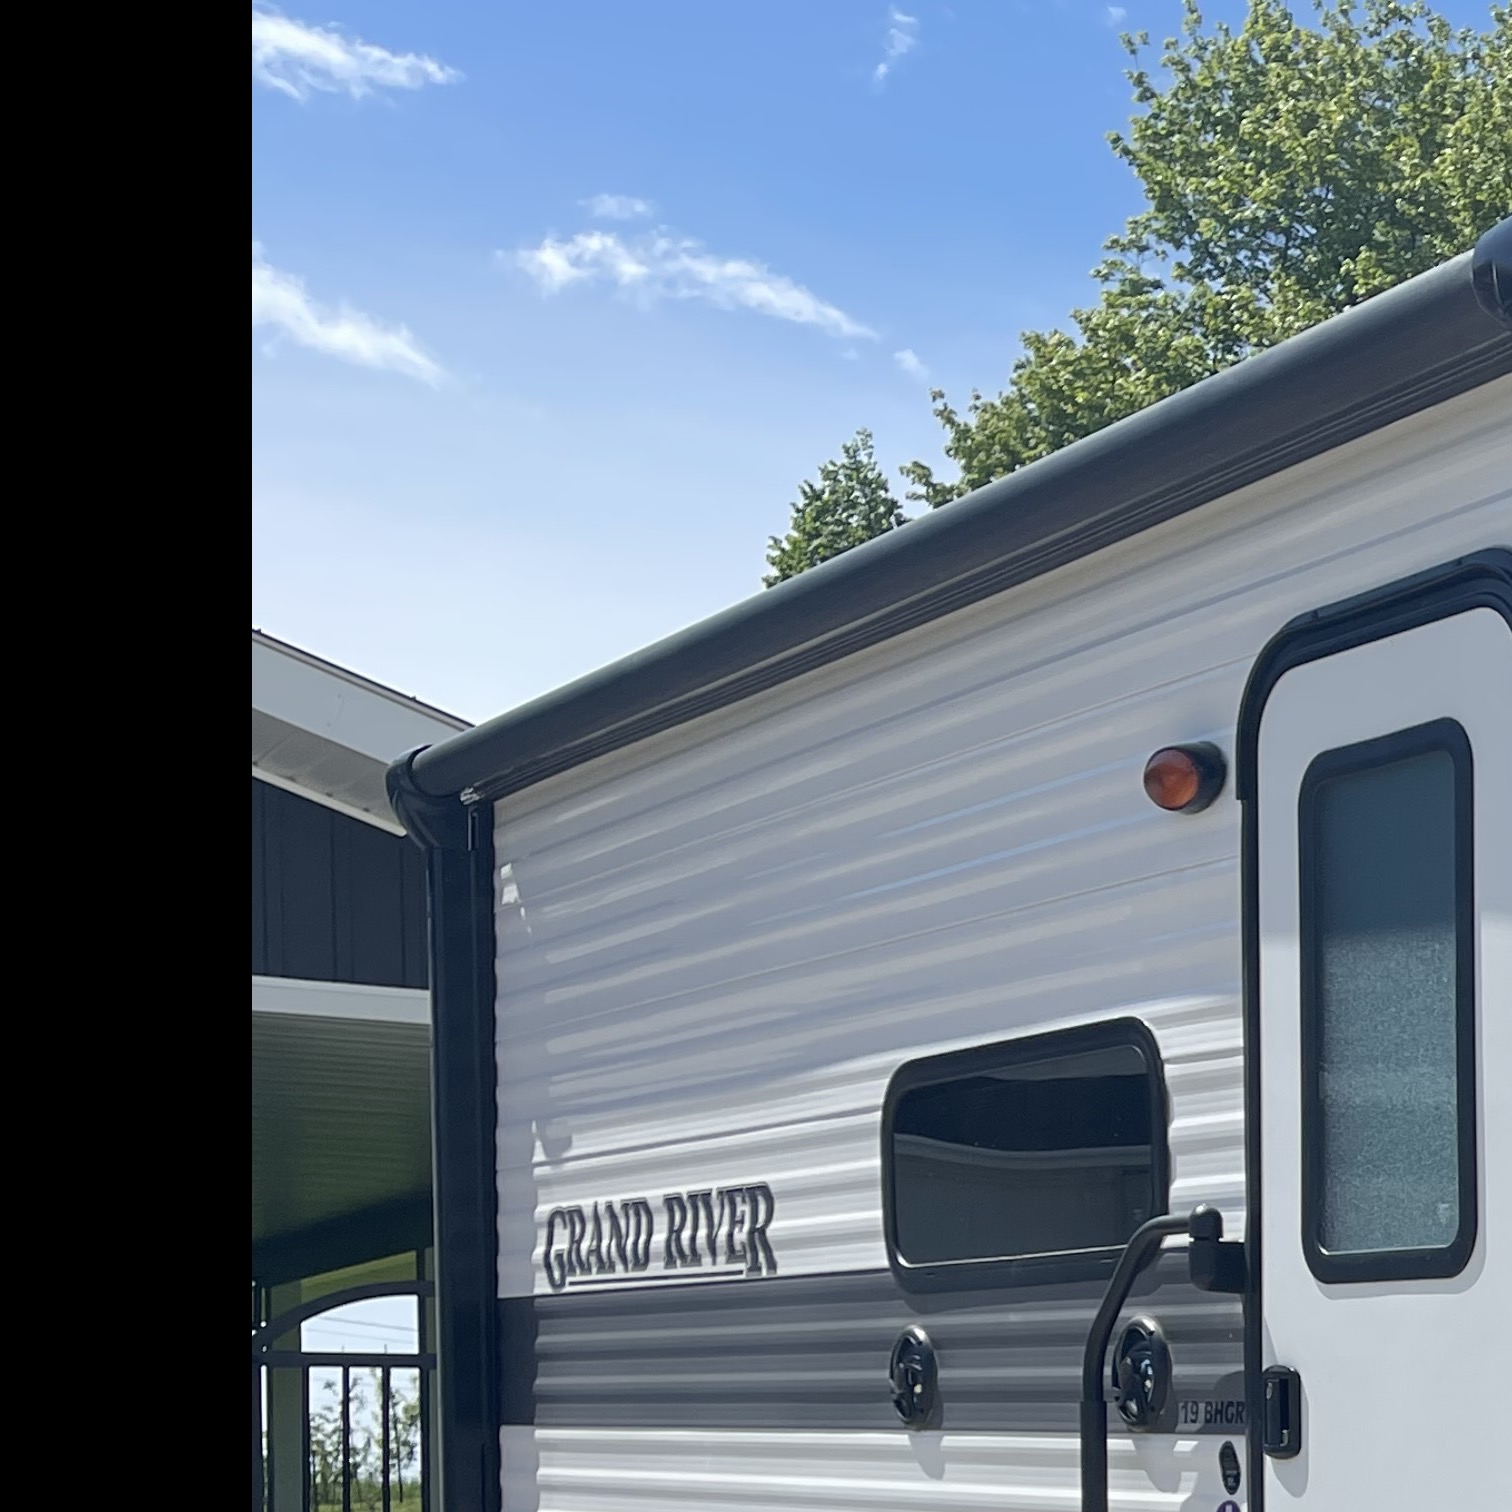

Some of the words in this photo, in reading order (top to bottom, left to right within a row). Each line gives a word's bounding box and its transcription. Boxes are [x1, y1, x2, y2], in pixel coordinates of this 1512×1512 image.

[543, 1196, 655, 1293] GRAND
[663, 1181, 778, 1278] RIVER
[1181, 1400, 1199, 1424] 19
[1204, 1400, 1246, 1424] BHGR
